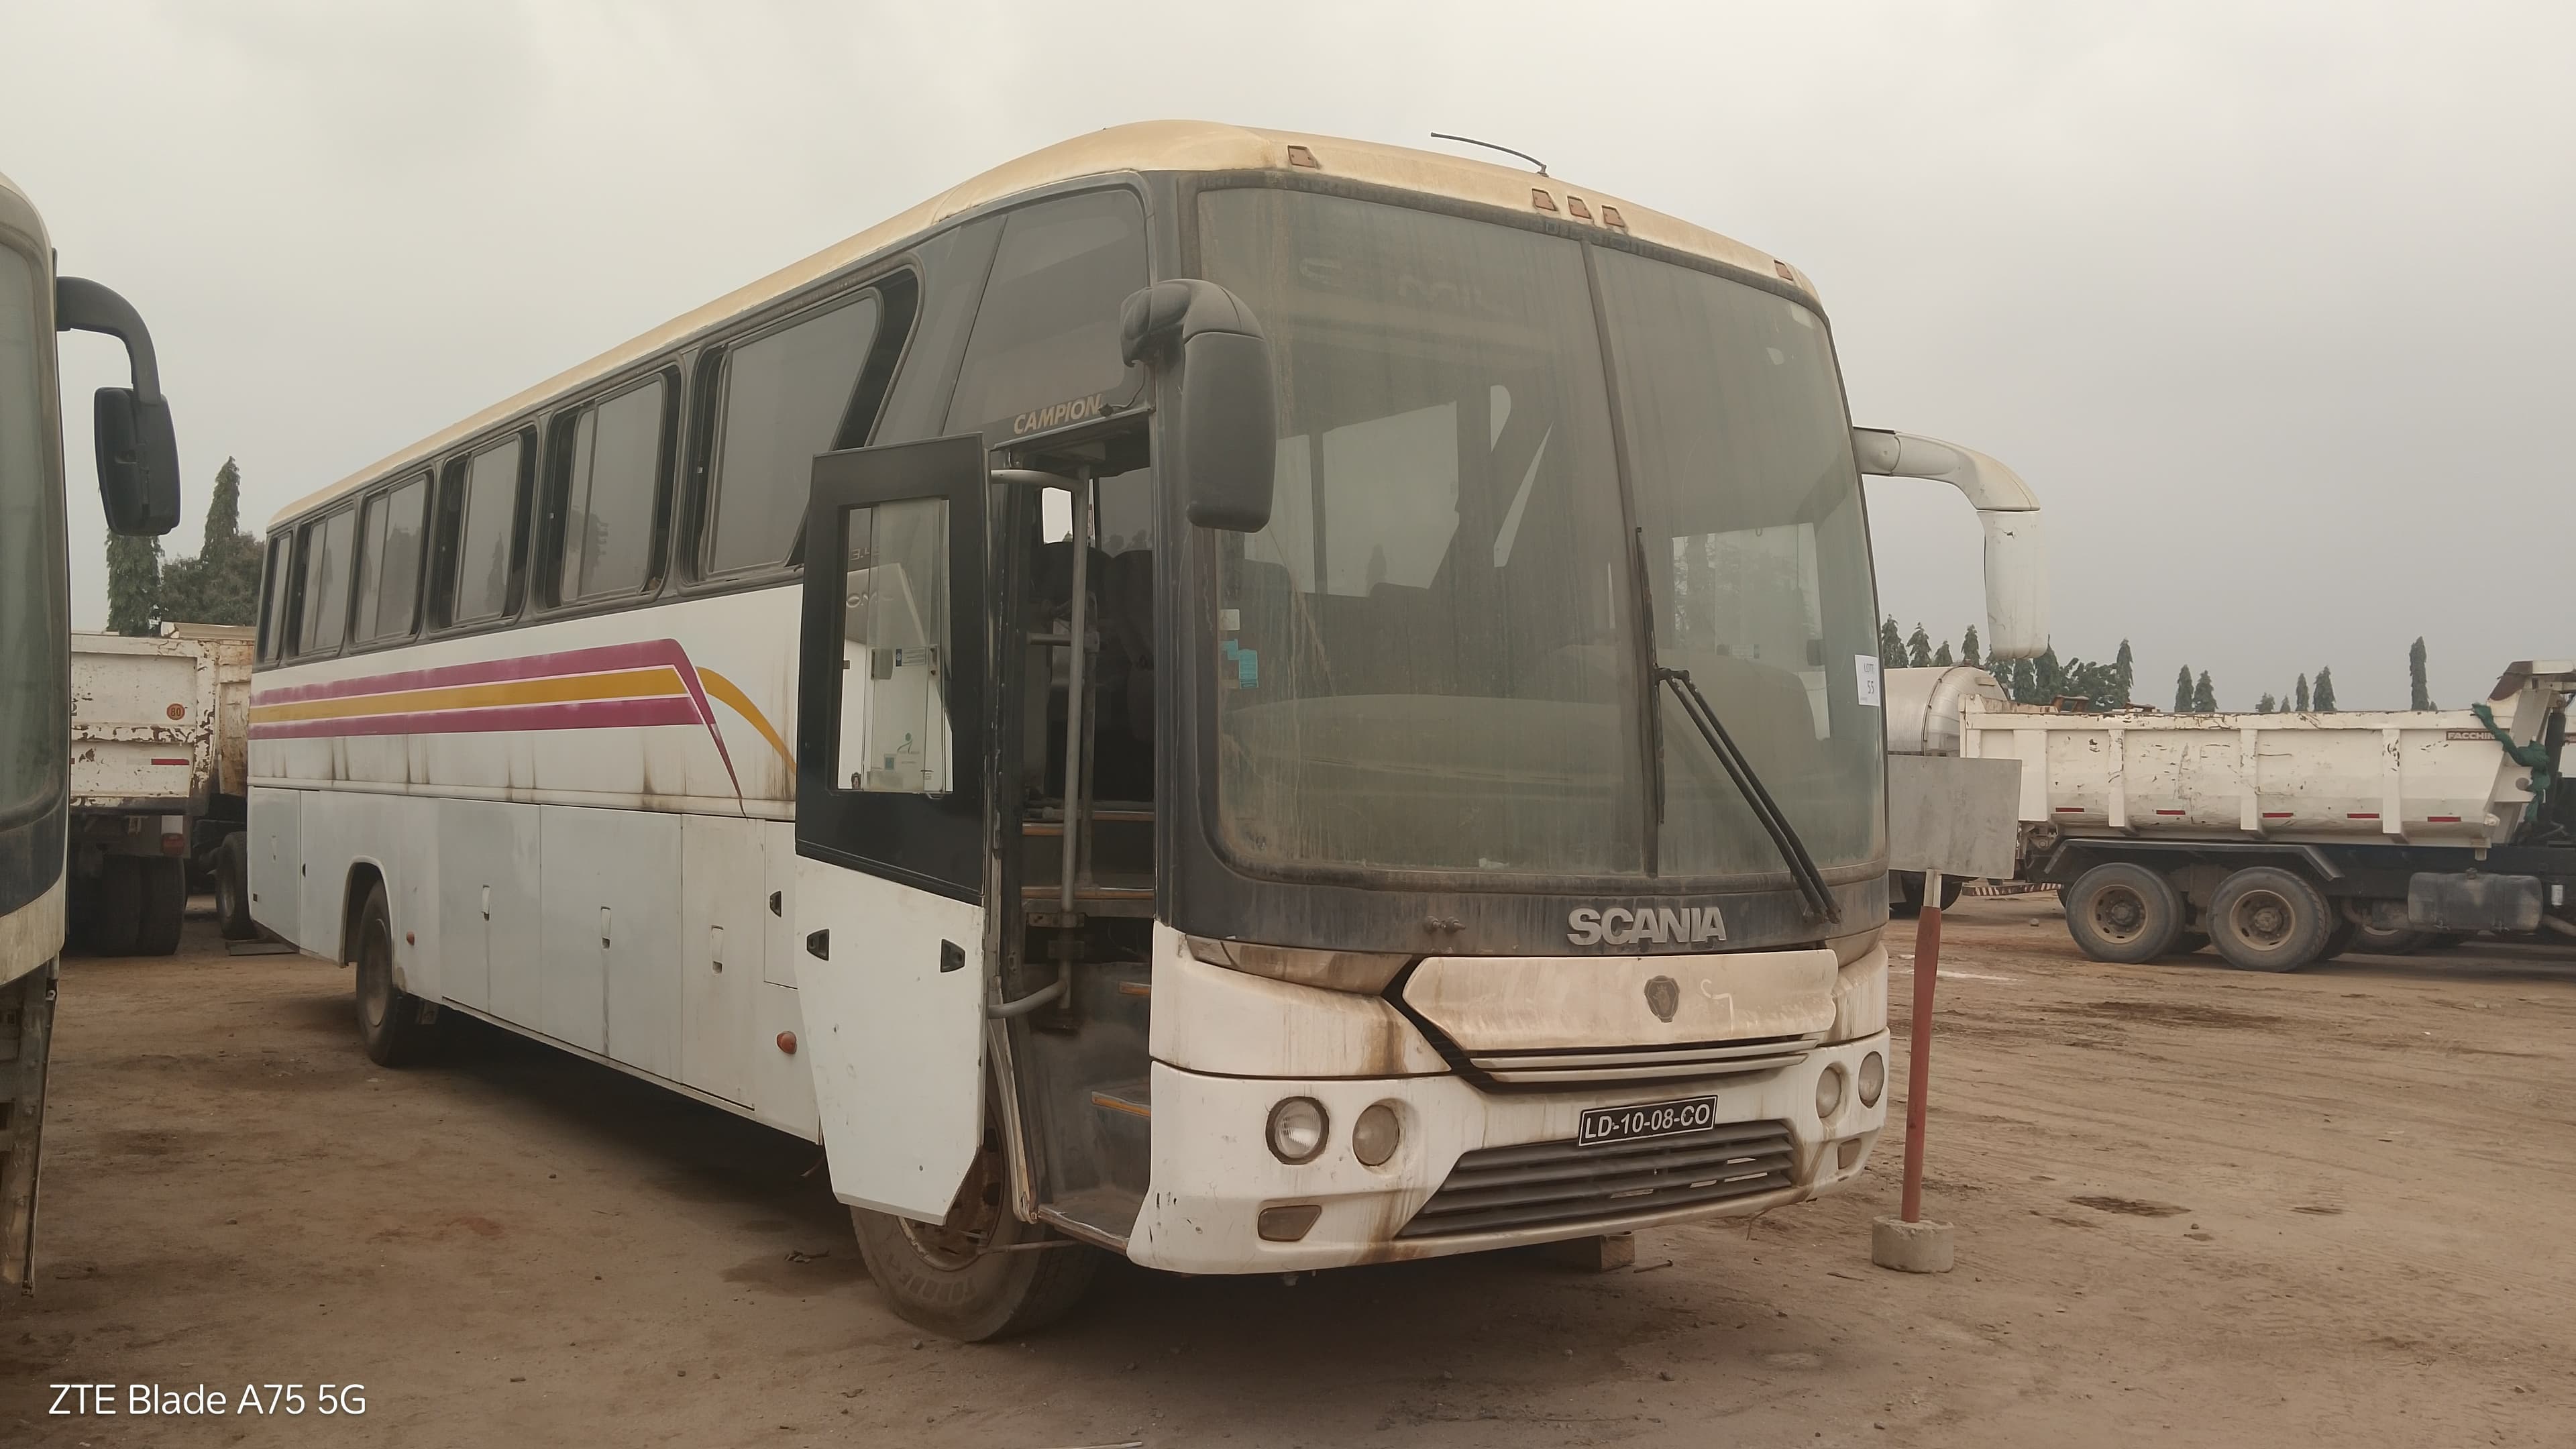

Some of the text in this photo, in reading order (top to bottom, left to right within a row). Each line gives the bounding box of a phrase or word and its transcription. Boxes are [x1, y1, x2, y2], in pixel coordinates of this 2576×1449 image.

[1014, 393, 1103, 435] CAMPION
[1868, 680, 1874, 694] 55
[1567, 907, 1727, 946] SCANIA
[1584, 1103, 1711, 1139] LD-10-08-CO
